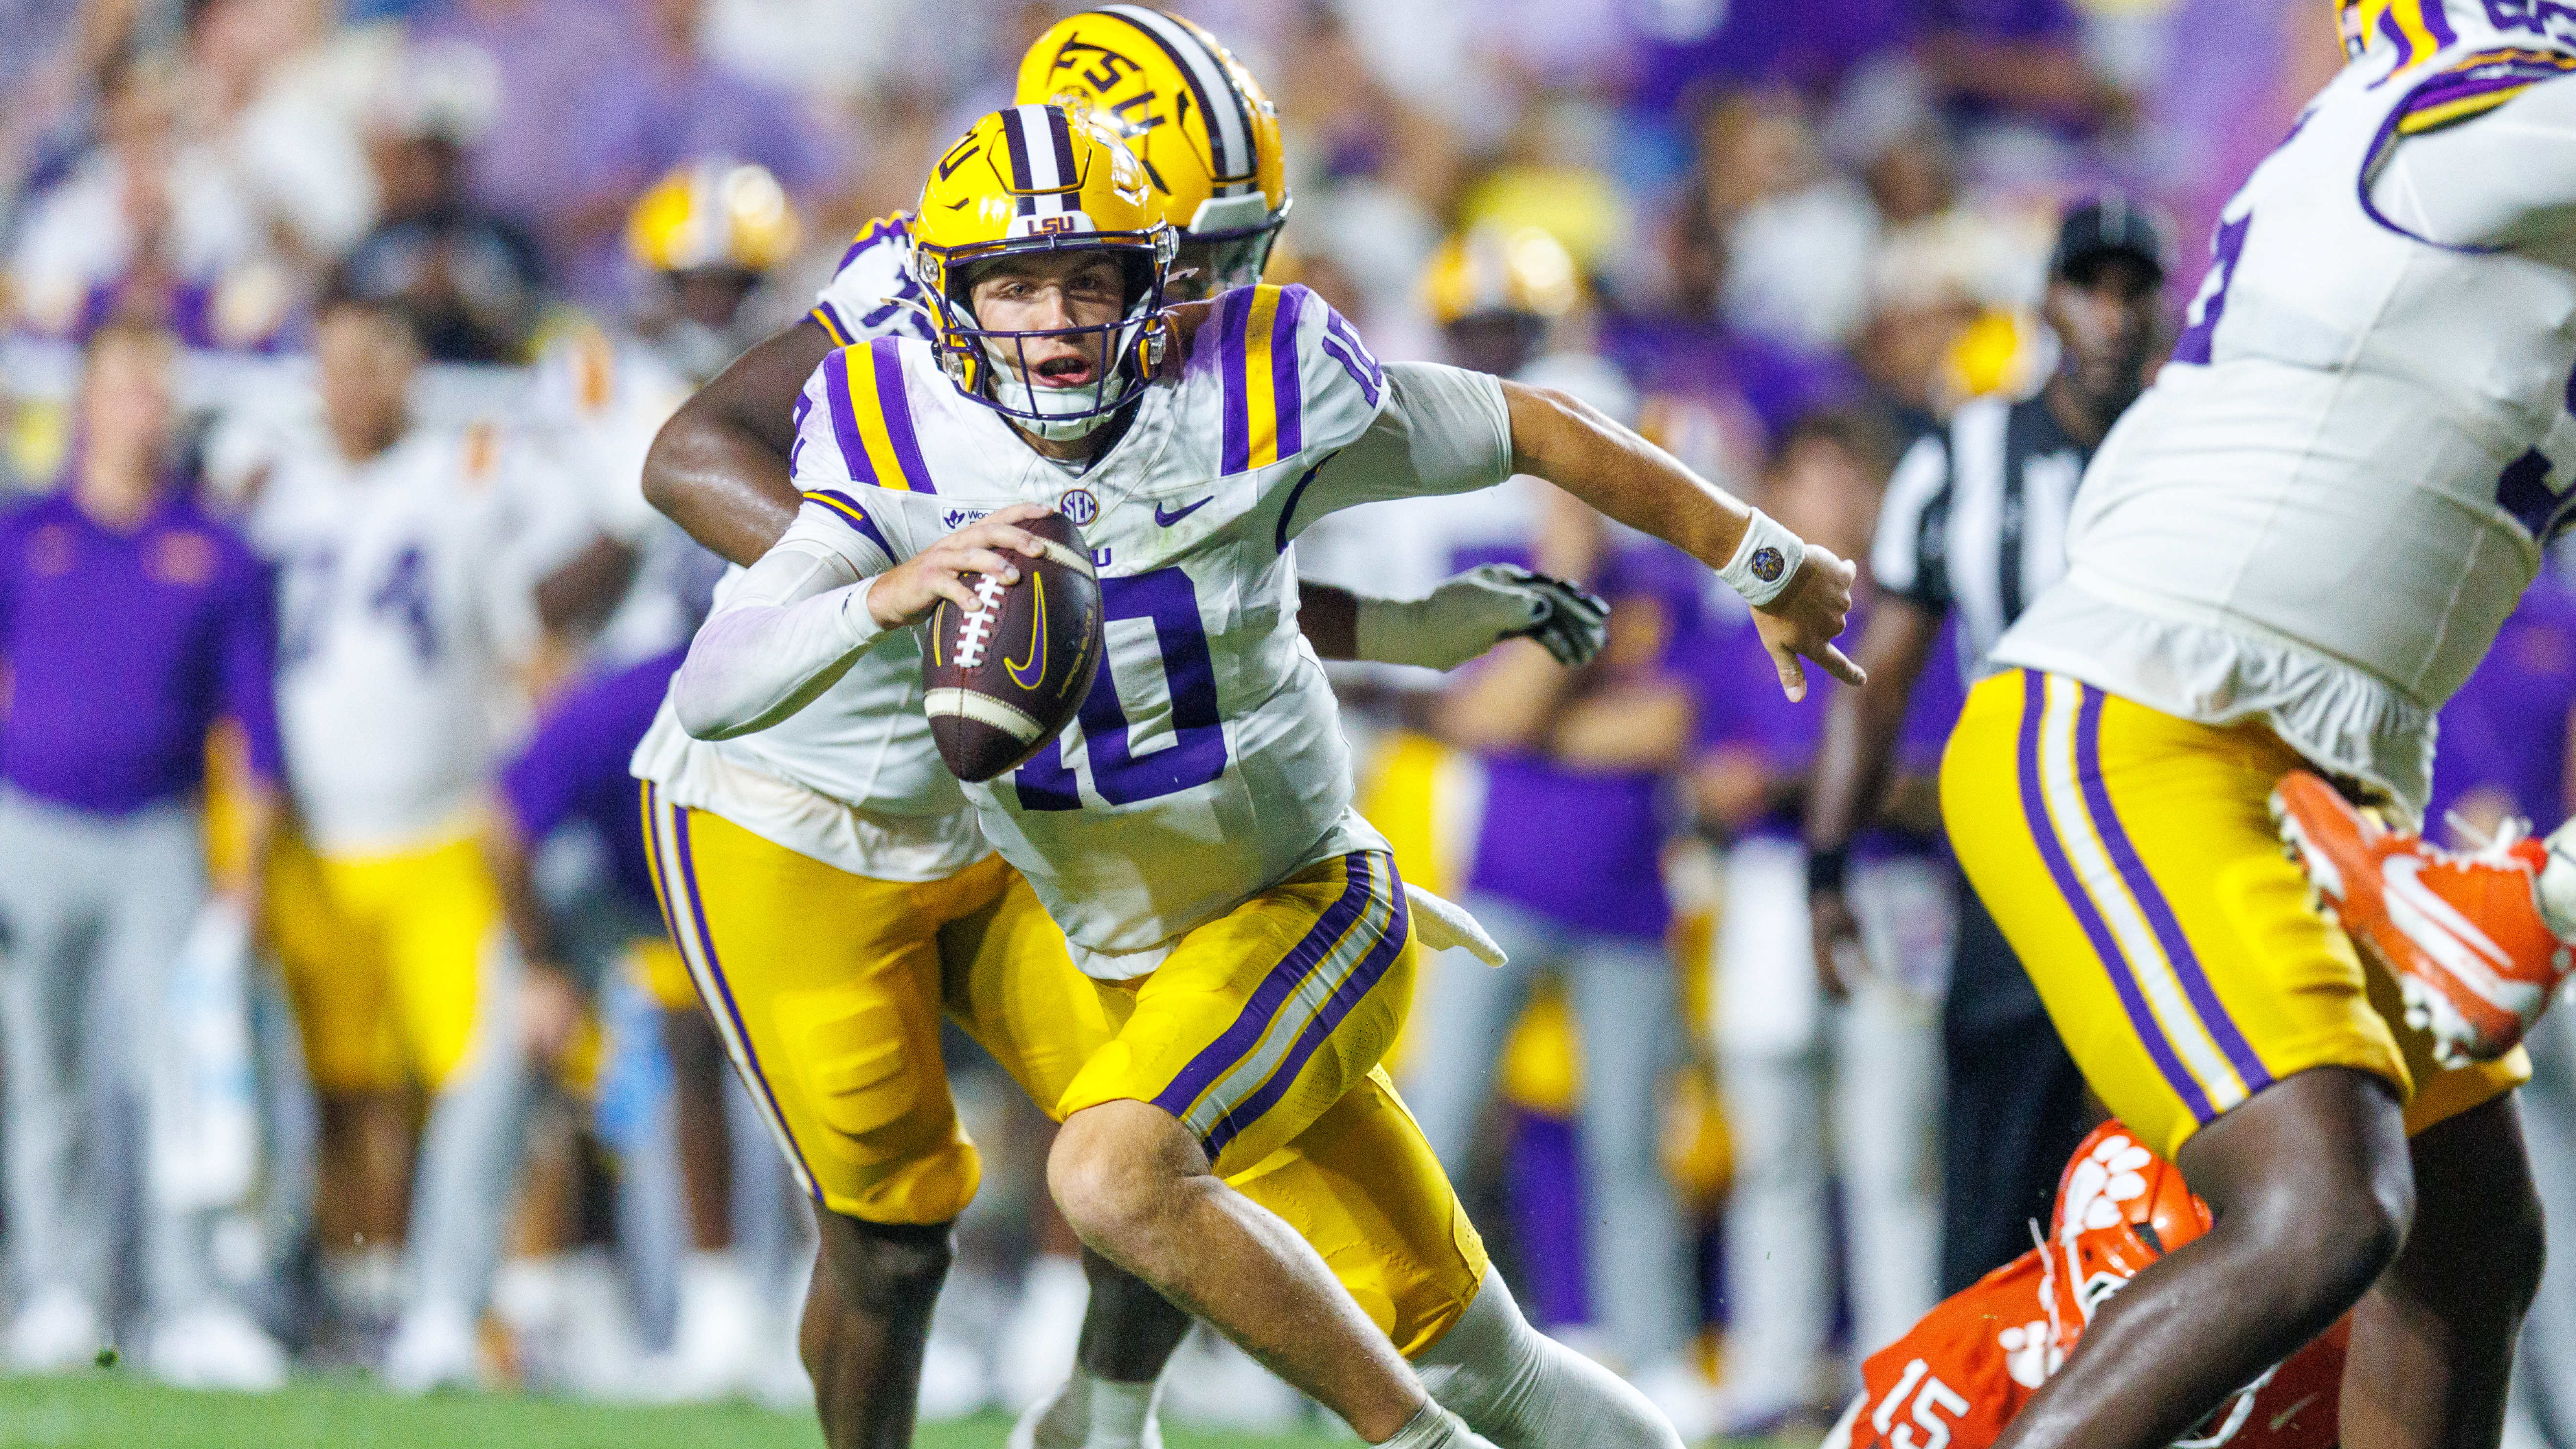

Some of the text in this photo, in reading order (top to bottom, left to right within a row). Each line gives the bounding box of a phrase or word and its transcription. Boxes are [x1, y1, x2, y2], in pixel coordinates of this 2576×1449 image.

[939, 130, 980, 182] U
[1027, 216, 1074, 236] LSU
[968, 510, 996, 519] Woo
[1062, 490, 1096, 524] SEC
[1091, 547, 1112, 567] U
[1872, 1358, 1971, 1449] 15
